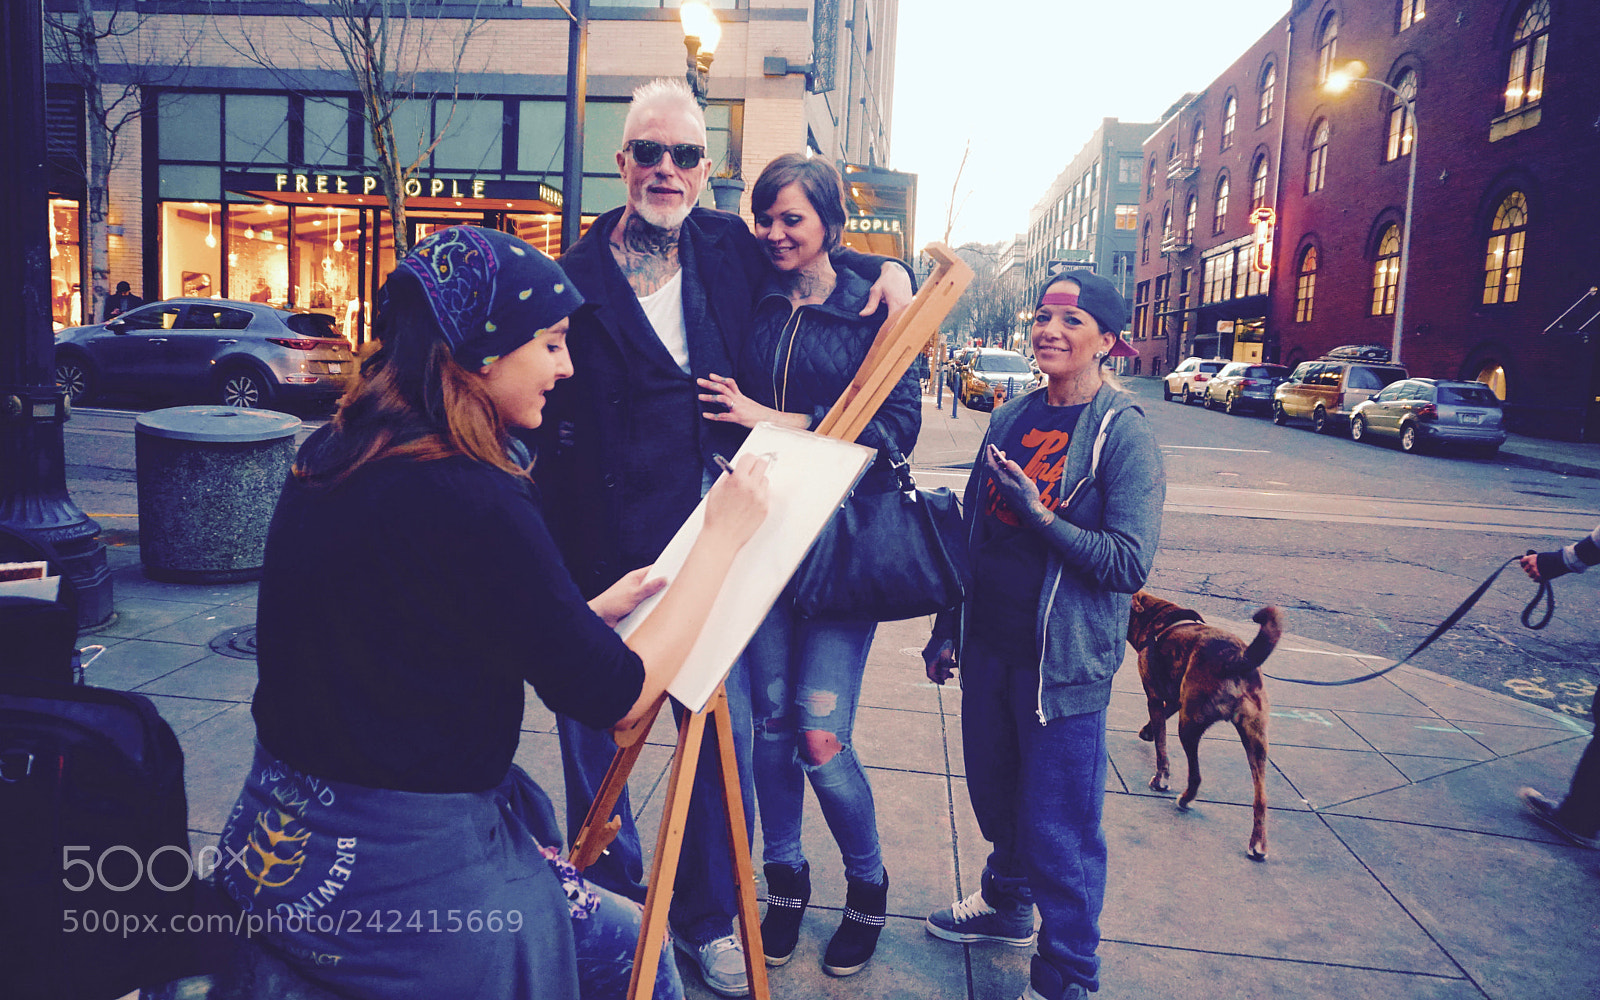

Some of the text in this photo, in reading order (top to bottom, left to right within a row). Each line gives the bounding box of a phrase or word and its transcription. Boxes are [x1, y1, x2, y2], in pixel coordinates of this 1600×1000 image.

[276, 173, 486, 199] FREE POPLE
[275, 836, 358, 921] BREWING
